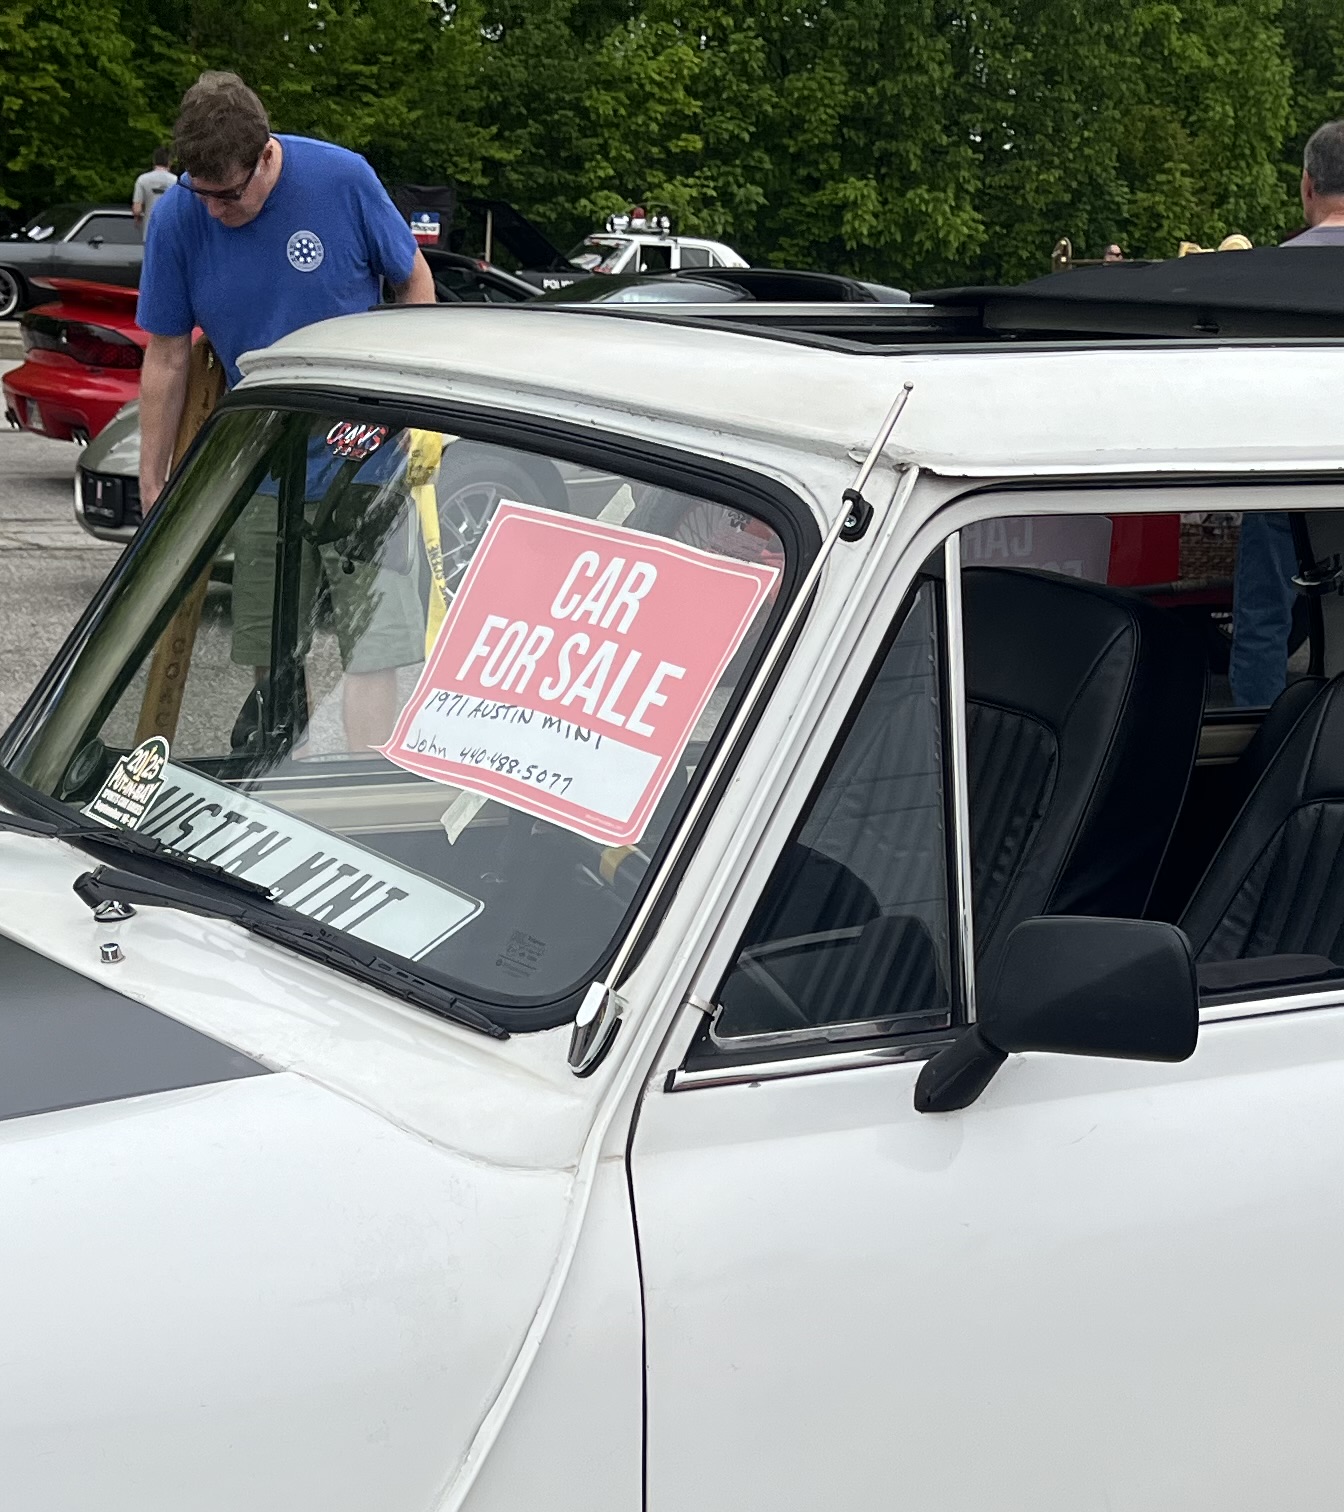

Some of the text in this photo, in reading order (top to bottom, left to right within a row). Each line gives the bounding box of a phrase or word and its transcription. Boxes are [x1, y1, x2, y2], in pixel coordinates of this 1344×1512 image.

[551, 550, 657, 634] CAR
[425, 691, 470, 717] 1971
[467, 699, 535, 724] AUSTIN
[456, 614, 686, 737] FOR SALE
[406, 729, 447, 758] John
[269, 851, 410, 933] MINI
